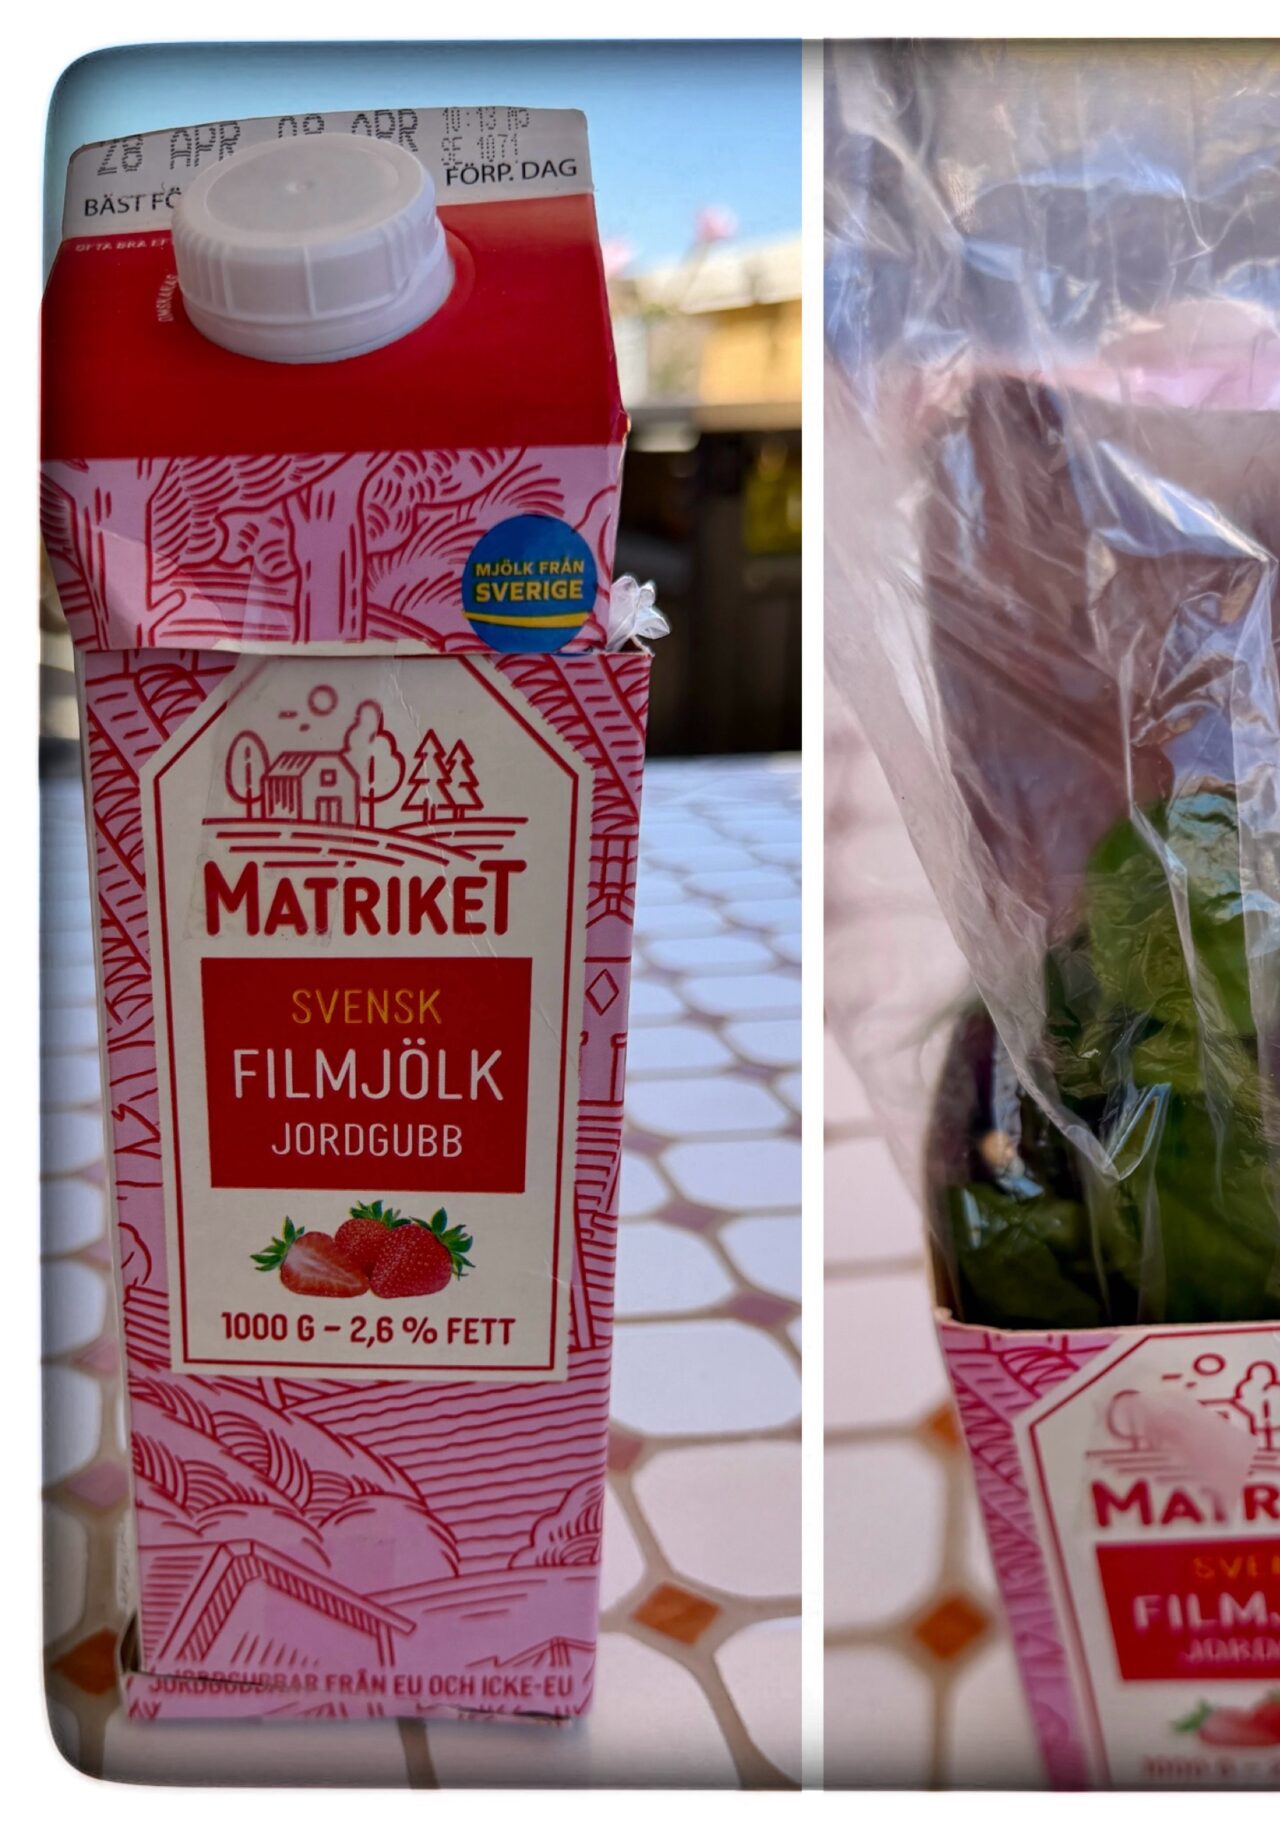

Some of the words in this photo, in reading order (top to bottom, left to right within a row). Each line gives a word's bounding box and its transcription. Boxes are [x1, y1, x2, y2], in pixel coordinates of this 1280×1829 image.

[169, 120, 240, 170] APR
[446, 162, 514, 186] FÖRP.
[521, 158, 577, 180] DAG
[84, 193, 147, 217] BÄST
[475, 557, 533, 576] MJÖLK
[539, 555, 585, 575] FRÅN
[475, 580, 584, 602] SVERIGE
[203, 859, 528, 937] MATRIKET
[291, 988, 442, 1025] SVENSK
[233, 1037, 505, 1101] FILMJÖLK
[271, 1122, 463, 1158] JORDGUBB
[221, 1311, 288, 1340] 1000
[296, 1314, 315, 1342] G
[350, 1315, 394, 1348] 2,6
[402, 1317, 438, 1344] %
[447, 1317, 516, 1345] FETT
[325, 1668, 386, 1694] FRÅN
[393, 1674, 422, 1696] EU
[429, 1674, 474, 1697] OCH
[482, 1674, 573, 1697] ICKE-EU
